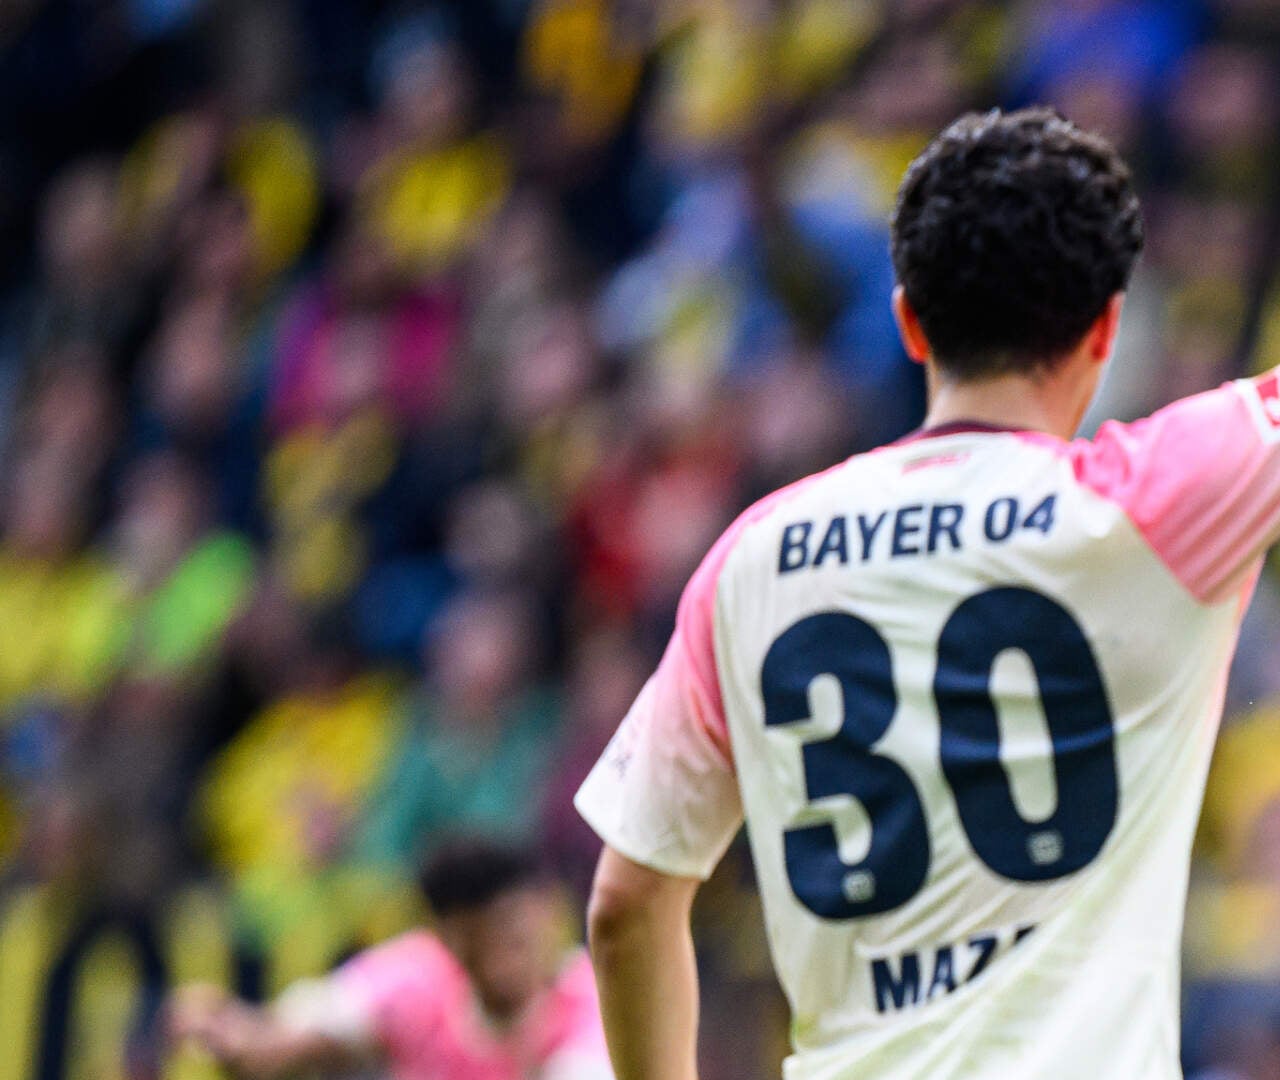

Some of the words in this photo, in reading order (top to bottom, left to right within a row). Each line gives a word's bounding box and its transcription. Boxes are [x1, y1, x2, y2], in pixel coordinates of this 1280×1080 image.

[778, 502, 964, 574] BAYER
[983, 492, 1057, 543] 04
[760, 586, 1120, 922] 30
[871, 924, 1036, 1013] MAZ
